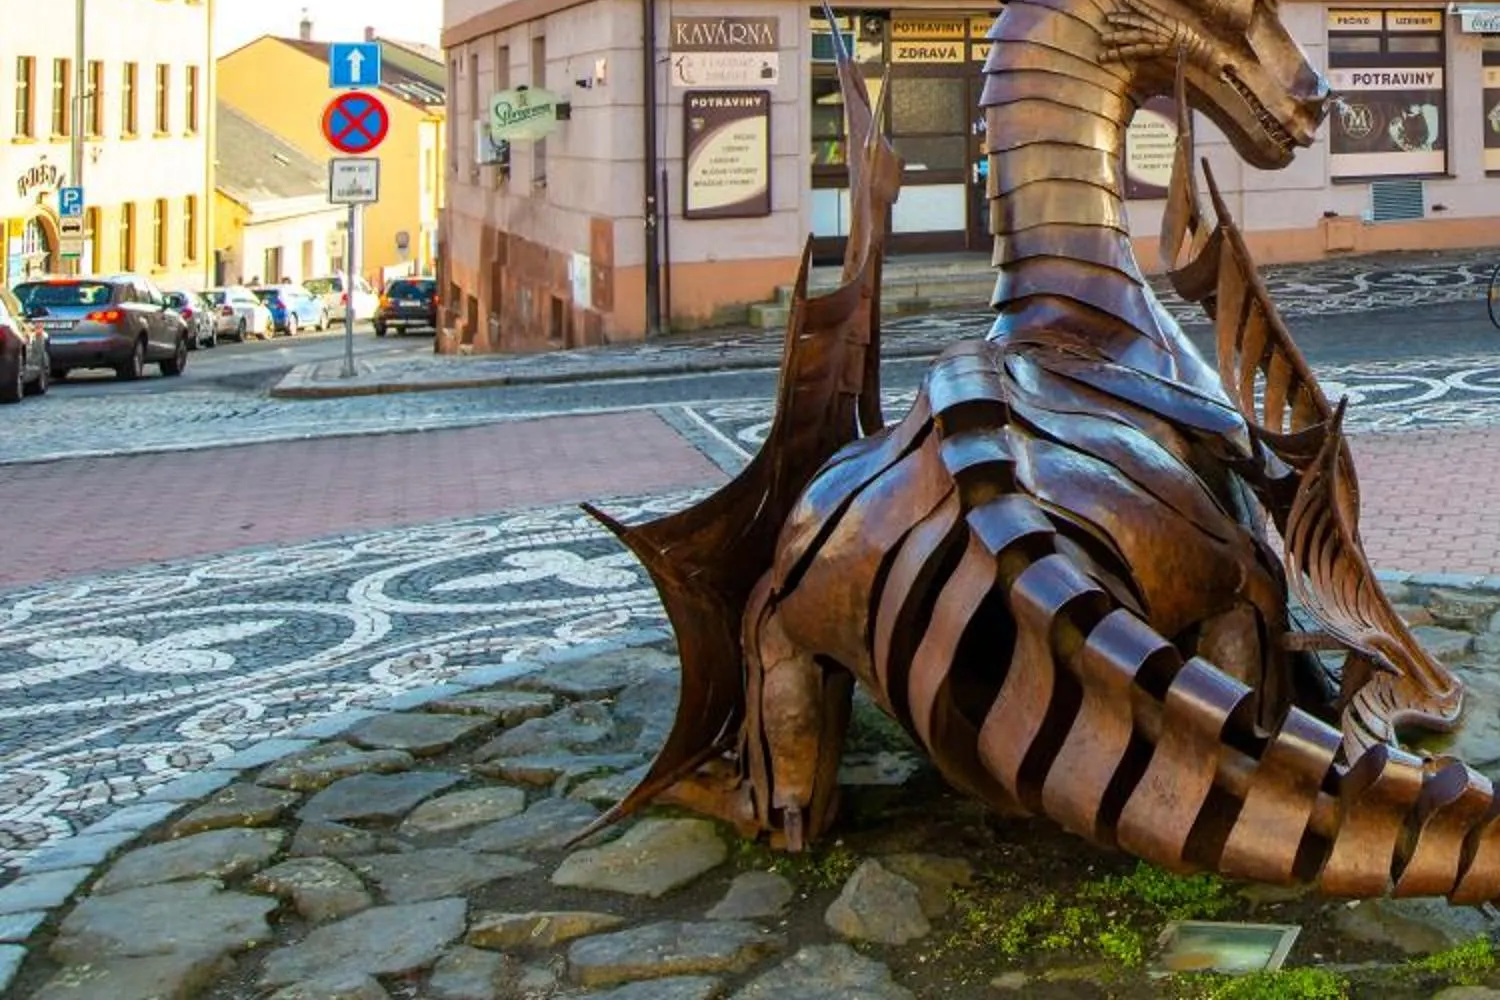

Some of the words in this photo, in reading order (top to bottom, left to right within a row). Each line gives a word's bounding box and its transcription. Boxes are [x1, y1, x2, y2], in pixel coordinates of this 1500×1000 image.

[676, 18, 774, 45] KAVÁRNA
[893, 22, 963, 33] POTRAVINY
[898, 45, 957, 60] ZDRAVÁ
[1352, 71, 1435, 85] POTRAVINY
[691, 96, 762, 108] POTRAVINY
